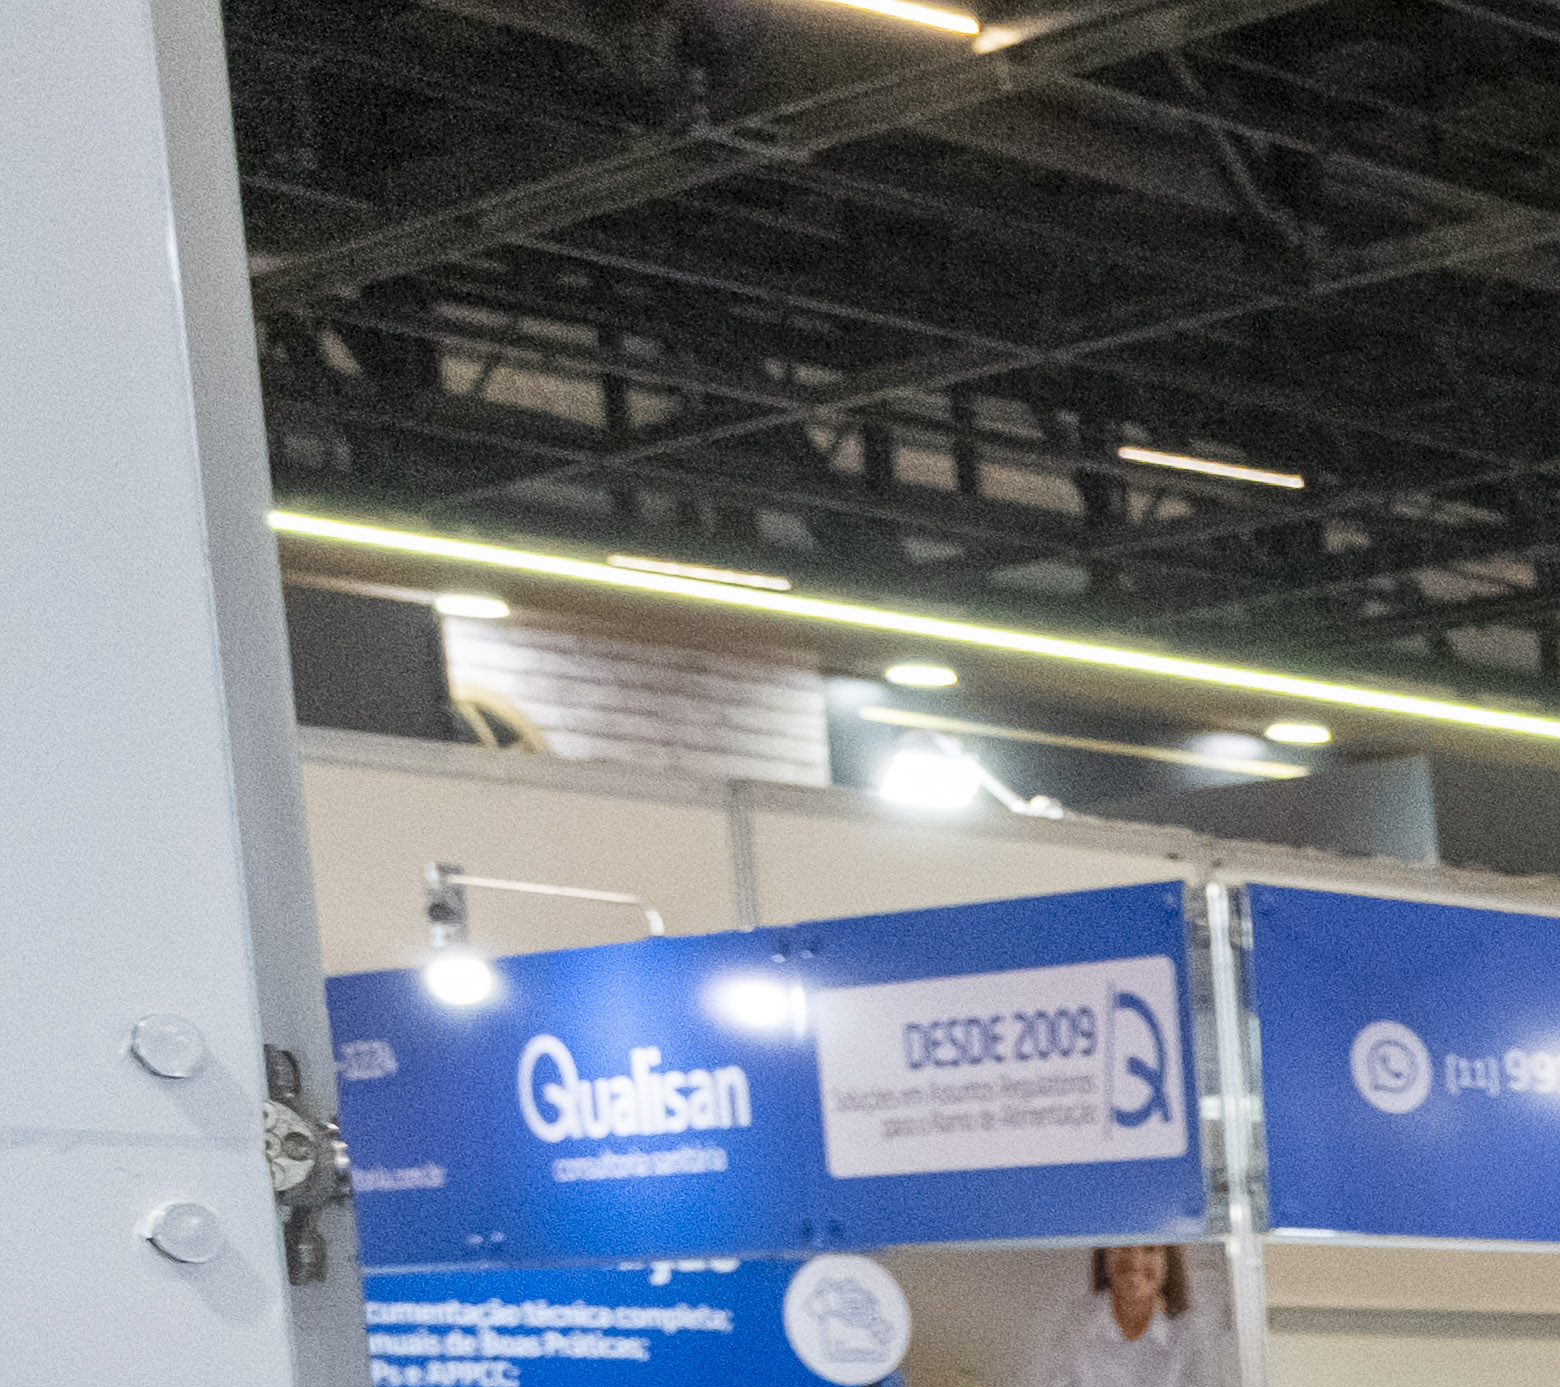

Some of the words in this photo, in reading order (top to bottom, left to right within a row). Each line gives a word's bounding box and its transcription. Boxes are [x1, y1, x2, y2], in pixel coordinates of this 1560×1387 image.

[903, 1014, 1005, 1070] DESDE
[1013, 1006, 1098, 1062] 2009
[517, 1034, 753, 1143] Qualisan
[366, 1298, 520, 1328] cumentação
